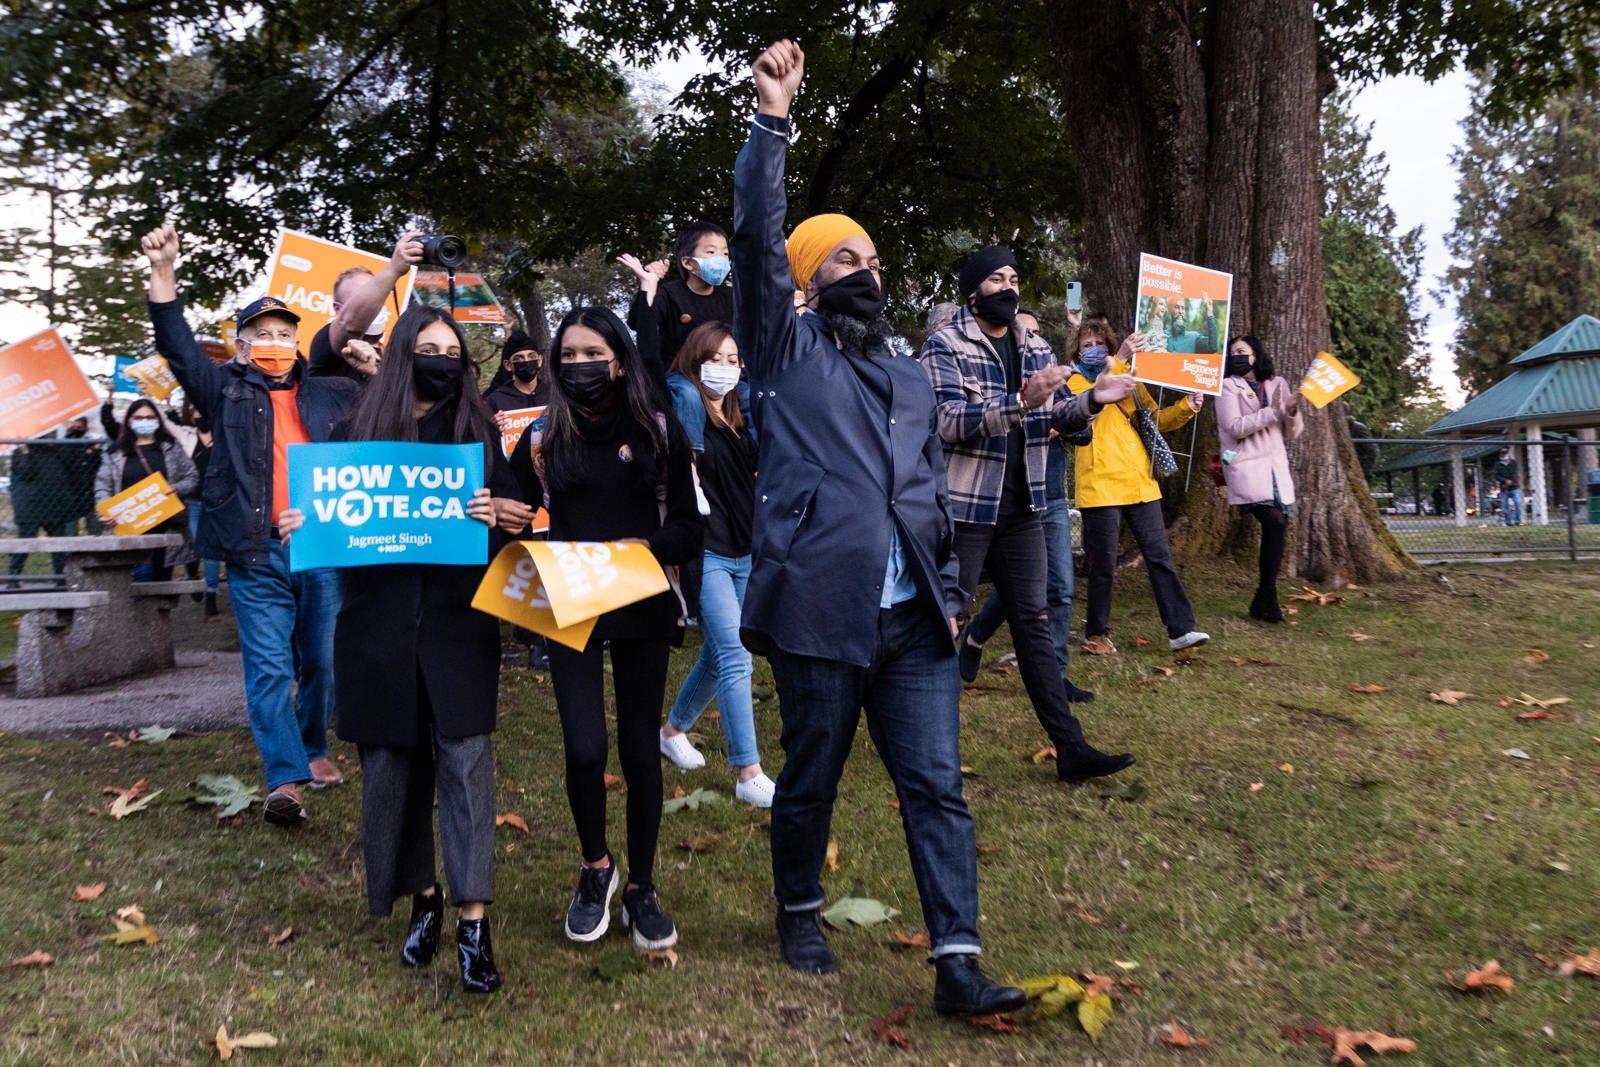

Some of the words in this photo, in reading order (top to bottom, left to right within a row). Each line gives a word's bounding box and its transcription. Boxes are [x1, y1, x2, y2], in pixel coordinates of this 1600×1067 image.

[1142, 261, 1172, 276] Better
[1174, 268, 1183, 280] is
[275, 283, 336, 316] JAGM
[1182, 359, 1219, 377] Jagmeet
[1194, 374, 1218, 388] Singh
[313, 464, 393, 492] HOW
[399, 465, 465, 490] YOU
[347, 533, 397, 550] Jagmeet
[398, 532, 432, 547] Singh
[503, 556, 538, 602] HO
